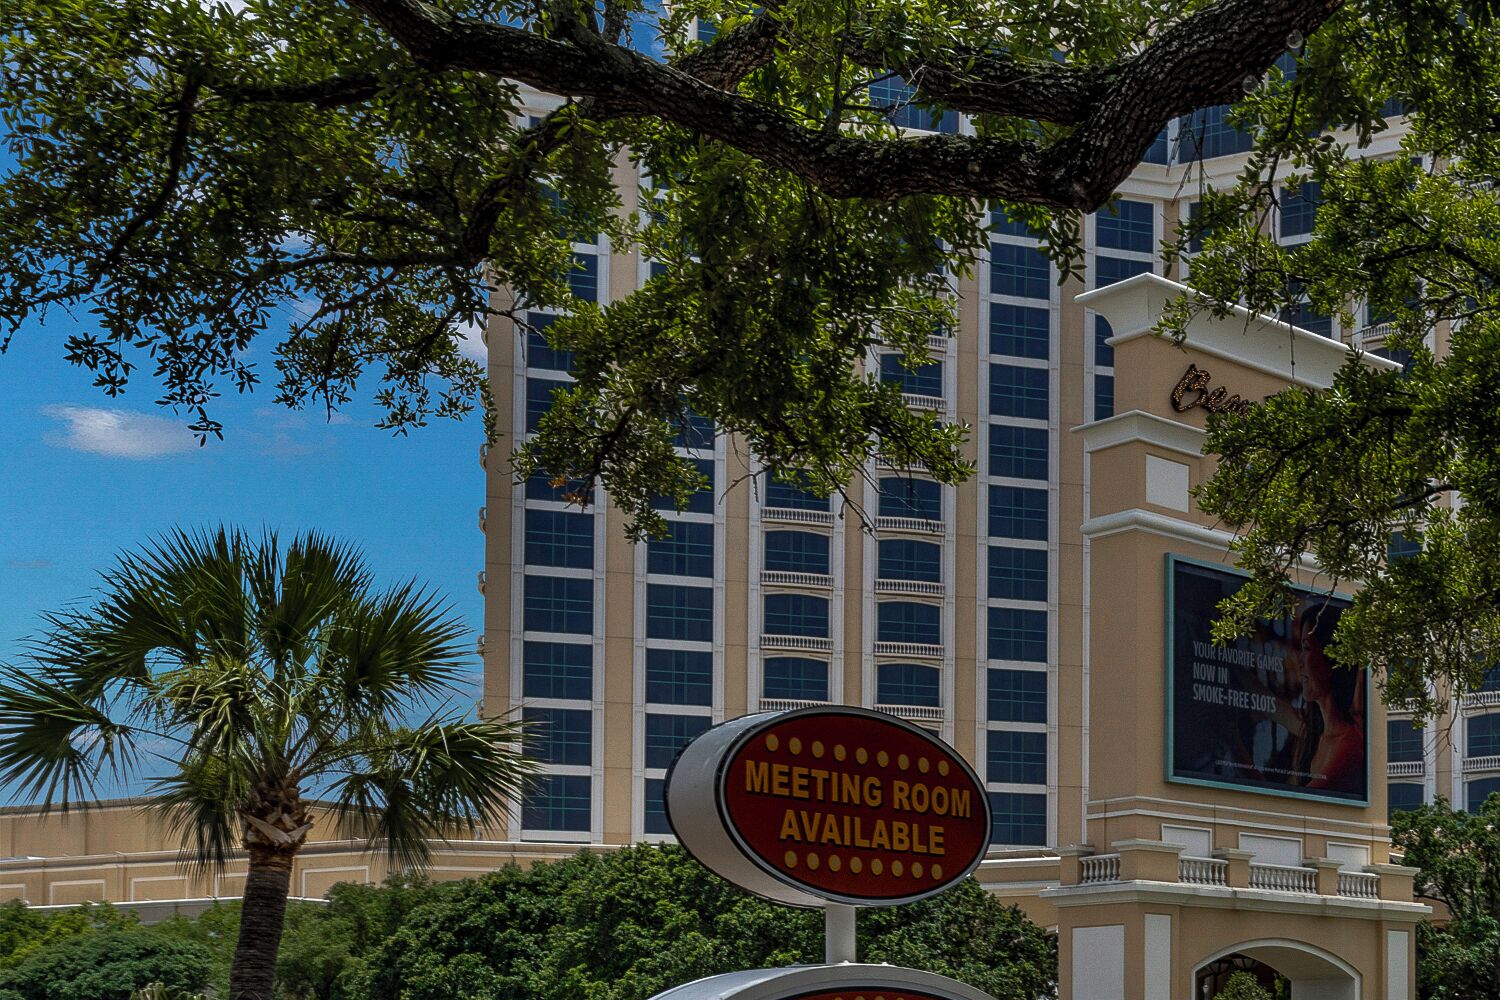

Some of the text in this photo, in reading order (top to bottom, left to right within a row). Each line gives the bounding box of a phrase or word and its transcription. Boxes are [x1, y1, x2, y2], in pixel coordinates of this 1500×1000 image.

[1193, 640, 1284, 673] YOUR FAVORITE GAMES
[1193, 662, 1228, 684] NOW IN
[1193, 683, 1277, 713] SMOKE-FREE SLOTS
[745, 760, 971, 818] MEETING ROOM
[779, 809, 945, 855] AVAILABLE
